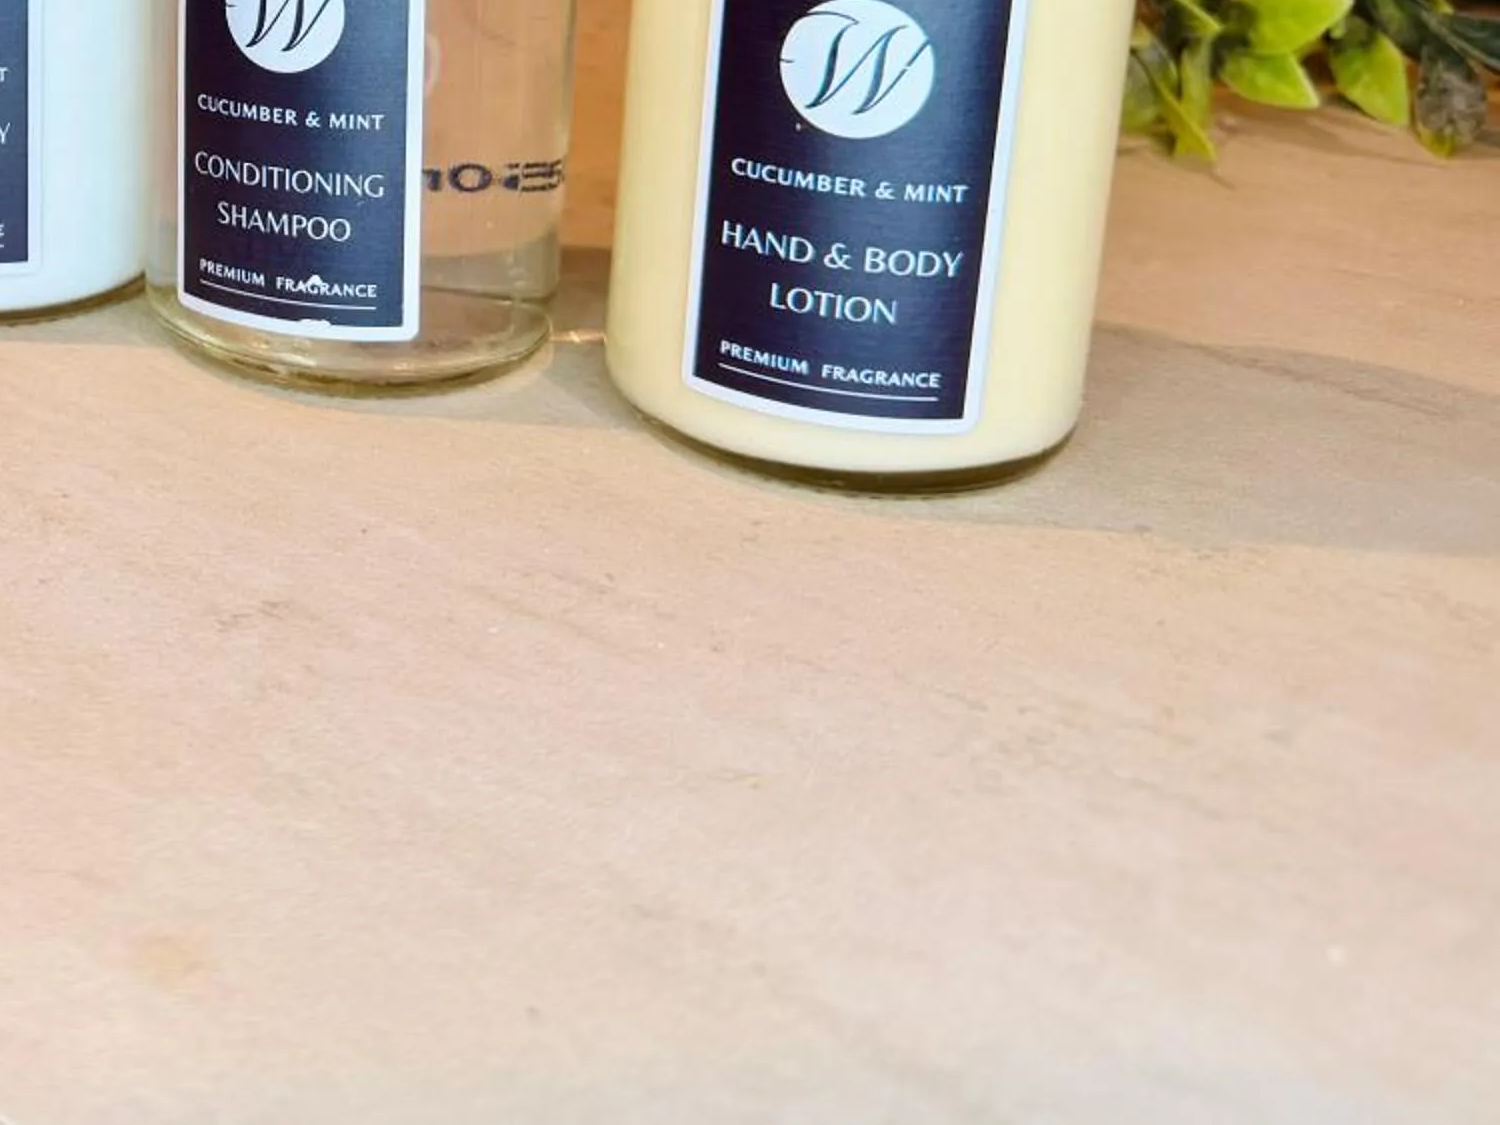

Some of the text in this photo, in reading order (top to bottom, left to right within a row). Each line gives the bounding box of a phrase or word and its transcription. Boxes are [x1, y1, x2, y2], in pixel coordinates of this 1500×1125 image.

[198, 94, 384, 130] CUCUMBER & MINT
[196, 152, 385, 198] CONDITIONING
[732, 158, 967, 202] CUCUMBER & MINT
[218, 202, 351, 242] SHAMPOO
[722, 221, 961, 277] HAND & BODY
[200, 259, 377, 297] PREMIUM FRAGRANCE
[771, 283, 897, 324] LOTION
[719, 341, 940, 387] PREMIUM FRAGRANCE
